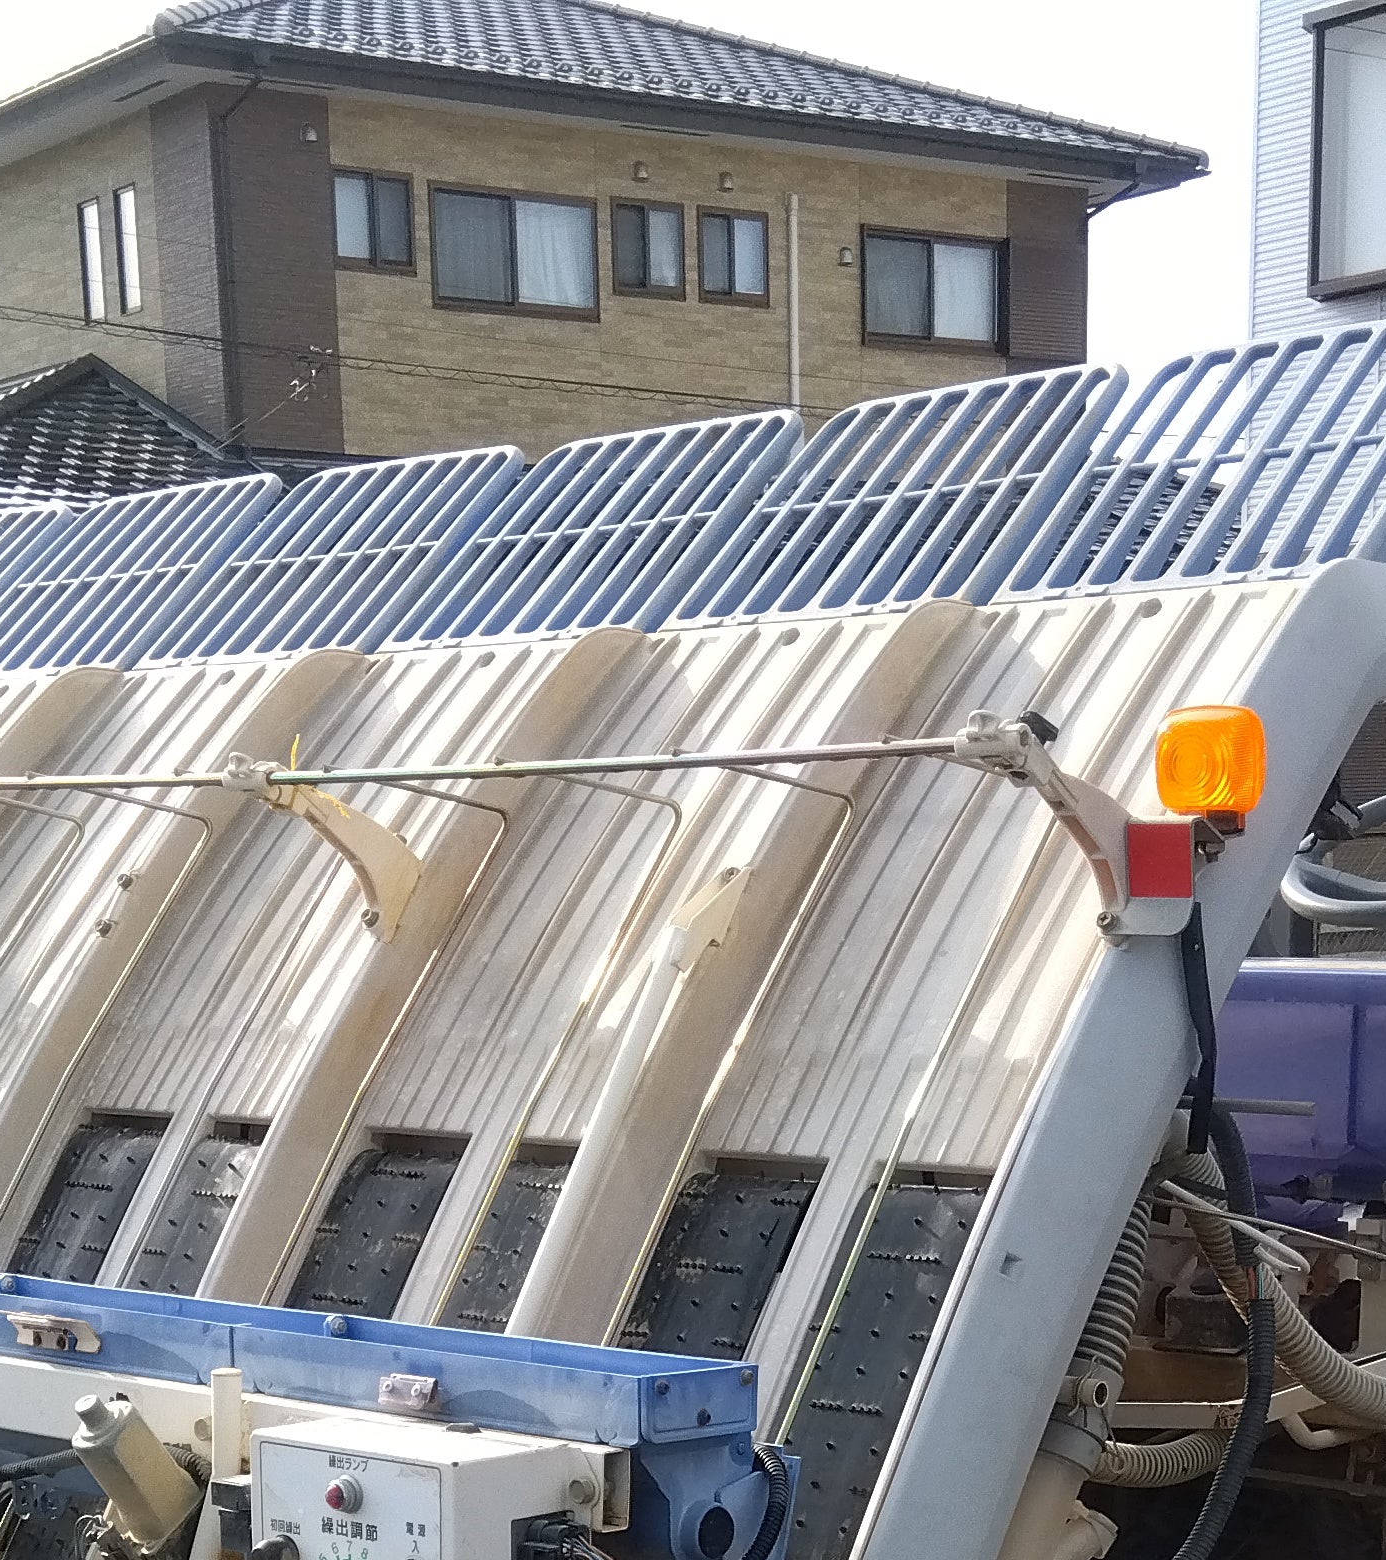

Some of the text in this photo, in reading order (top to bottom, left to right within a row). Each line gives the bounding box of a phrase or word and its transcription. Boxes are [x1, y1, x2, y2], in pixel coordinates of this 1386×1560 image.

[328, 1454, 369, 1472] 繰出ランプ
[321, 1516, 378, 1542] 繰出調節
[331, 1542, 339, 1555] 6
[346, 1540, 353, 1552] 7
[411, 1540, 420, 1554] 入
[360, 1547, 369, 1560] 8
